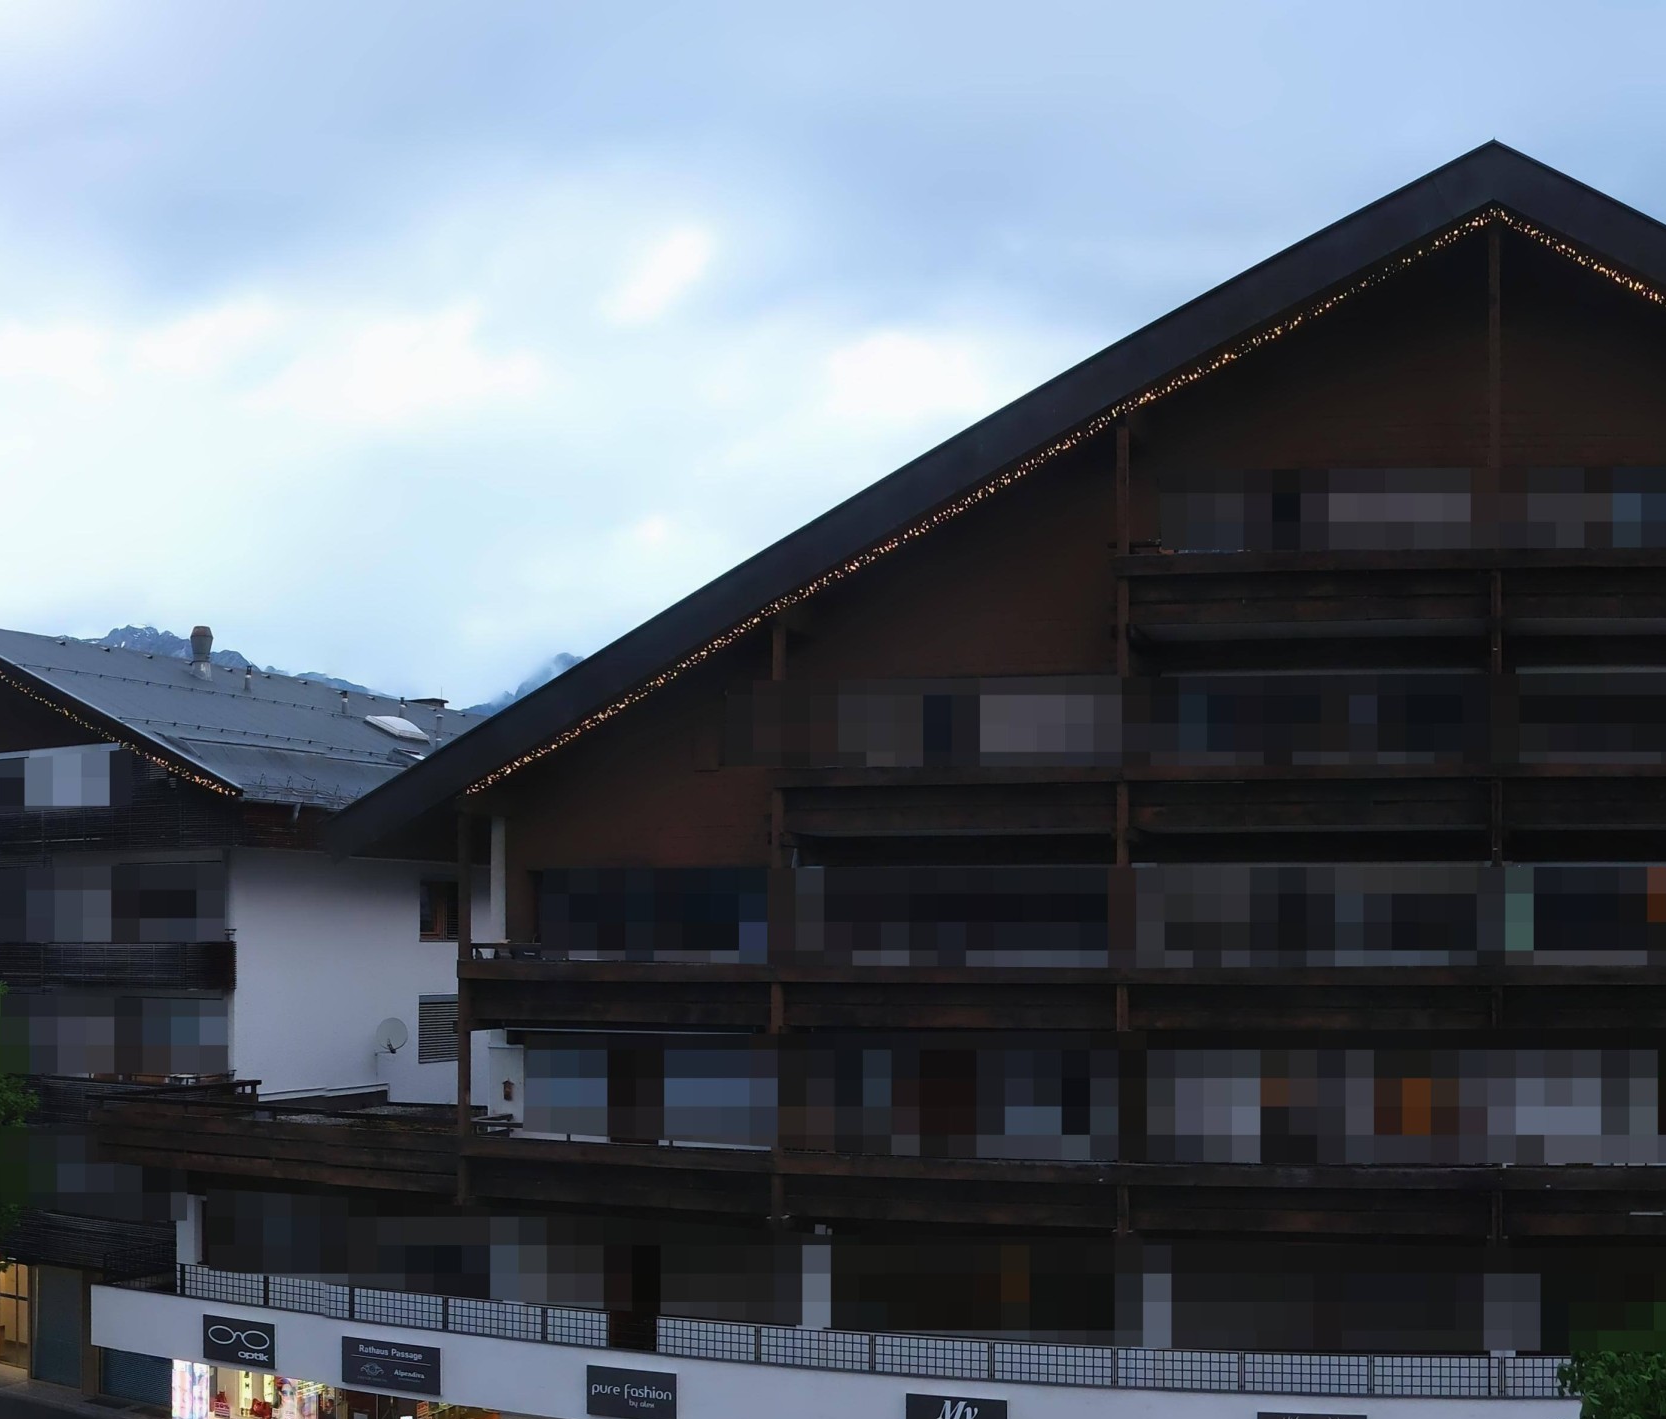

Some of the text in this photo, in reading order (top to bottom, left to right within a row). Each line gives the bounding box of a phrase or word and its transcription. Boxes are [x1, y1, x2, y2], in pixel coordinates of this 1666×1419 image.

[238, 1351, 269, 1362] optik
[358, 1344, 423, 1361] Rathaus Passage
[591, 1383, 672, 1401] pure fashion
